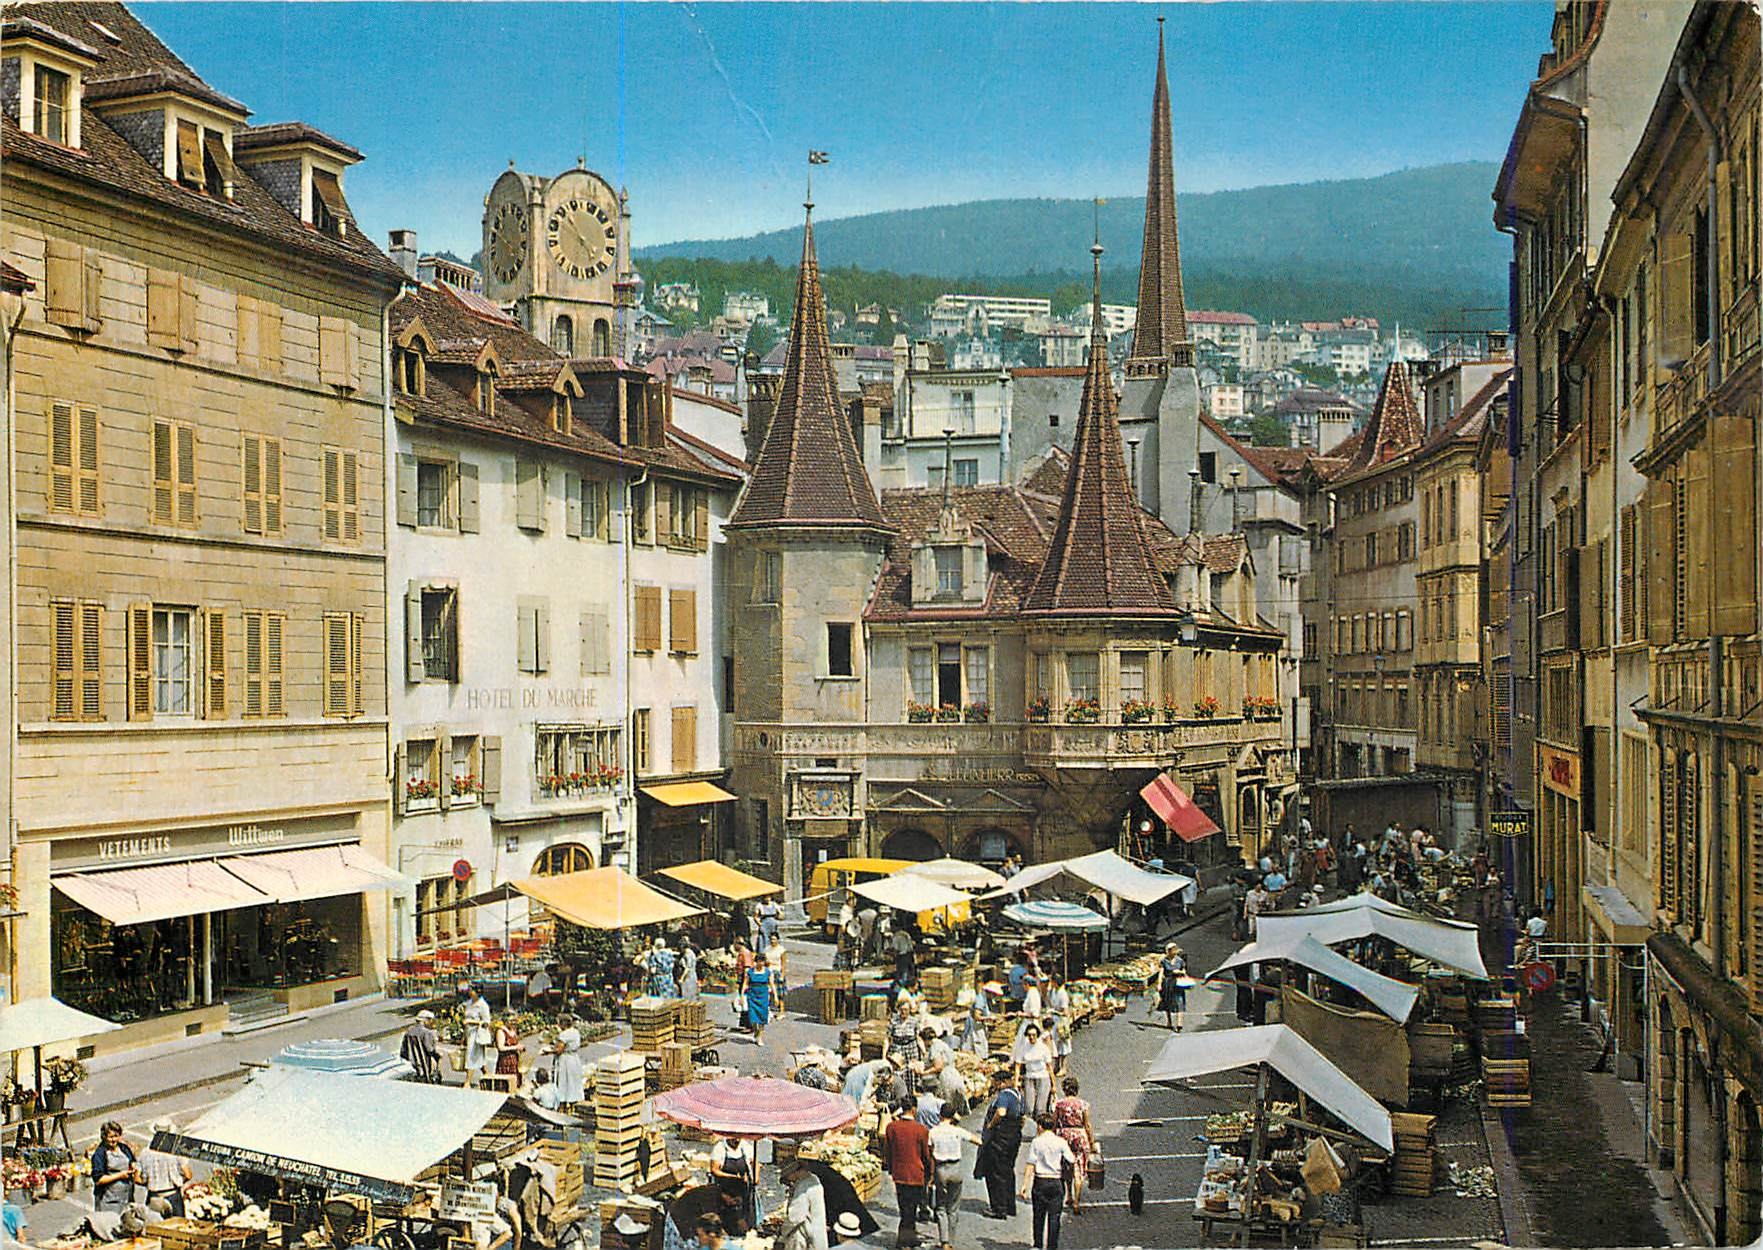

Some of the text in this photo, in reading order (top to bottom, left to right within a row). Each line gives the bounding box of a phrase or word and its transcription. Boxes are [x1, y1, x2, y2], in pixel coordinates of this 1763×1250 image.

[467, 687, 514, 709] HOTEL
[522, 687, 541, 708] DU
[1491, 822, 1527, 833] MURAT
[98, 836, 171, 859] VETEMENTS
